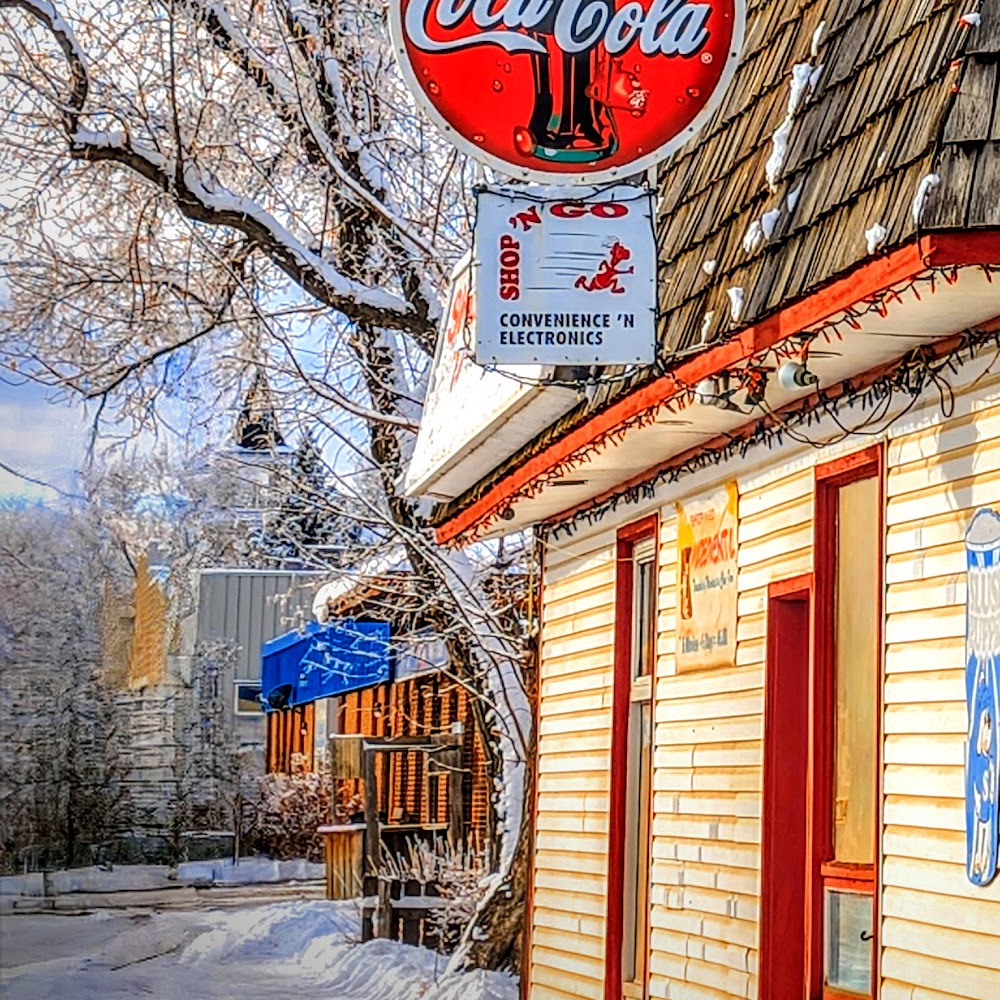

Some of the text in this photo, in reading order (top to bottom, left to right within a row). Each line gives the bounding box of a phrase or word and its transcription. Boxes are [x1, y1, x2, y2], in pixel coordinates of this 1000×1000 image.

[500, 234, 520, 301] SHOP
[550, 202, 629, 219] GO
[500, 313, 635, 328] CONVENIENCE 'N
[500, 331, 604, 345] ELECTRONICS
